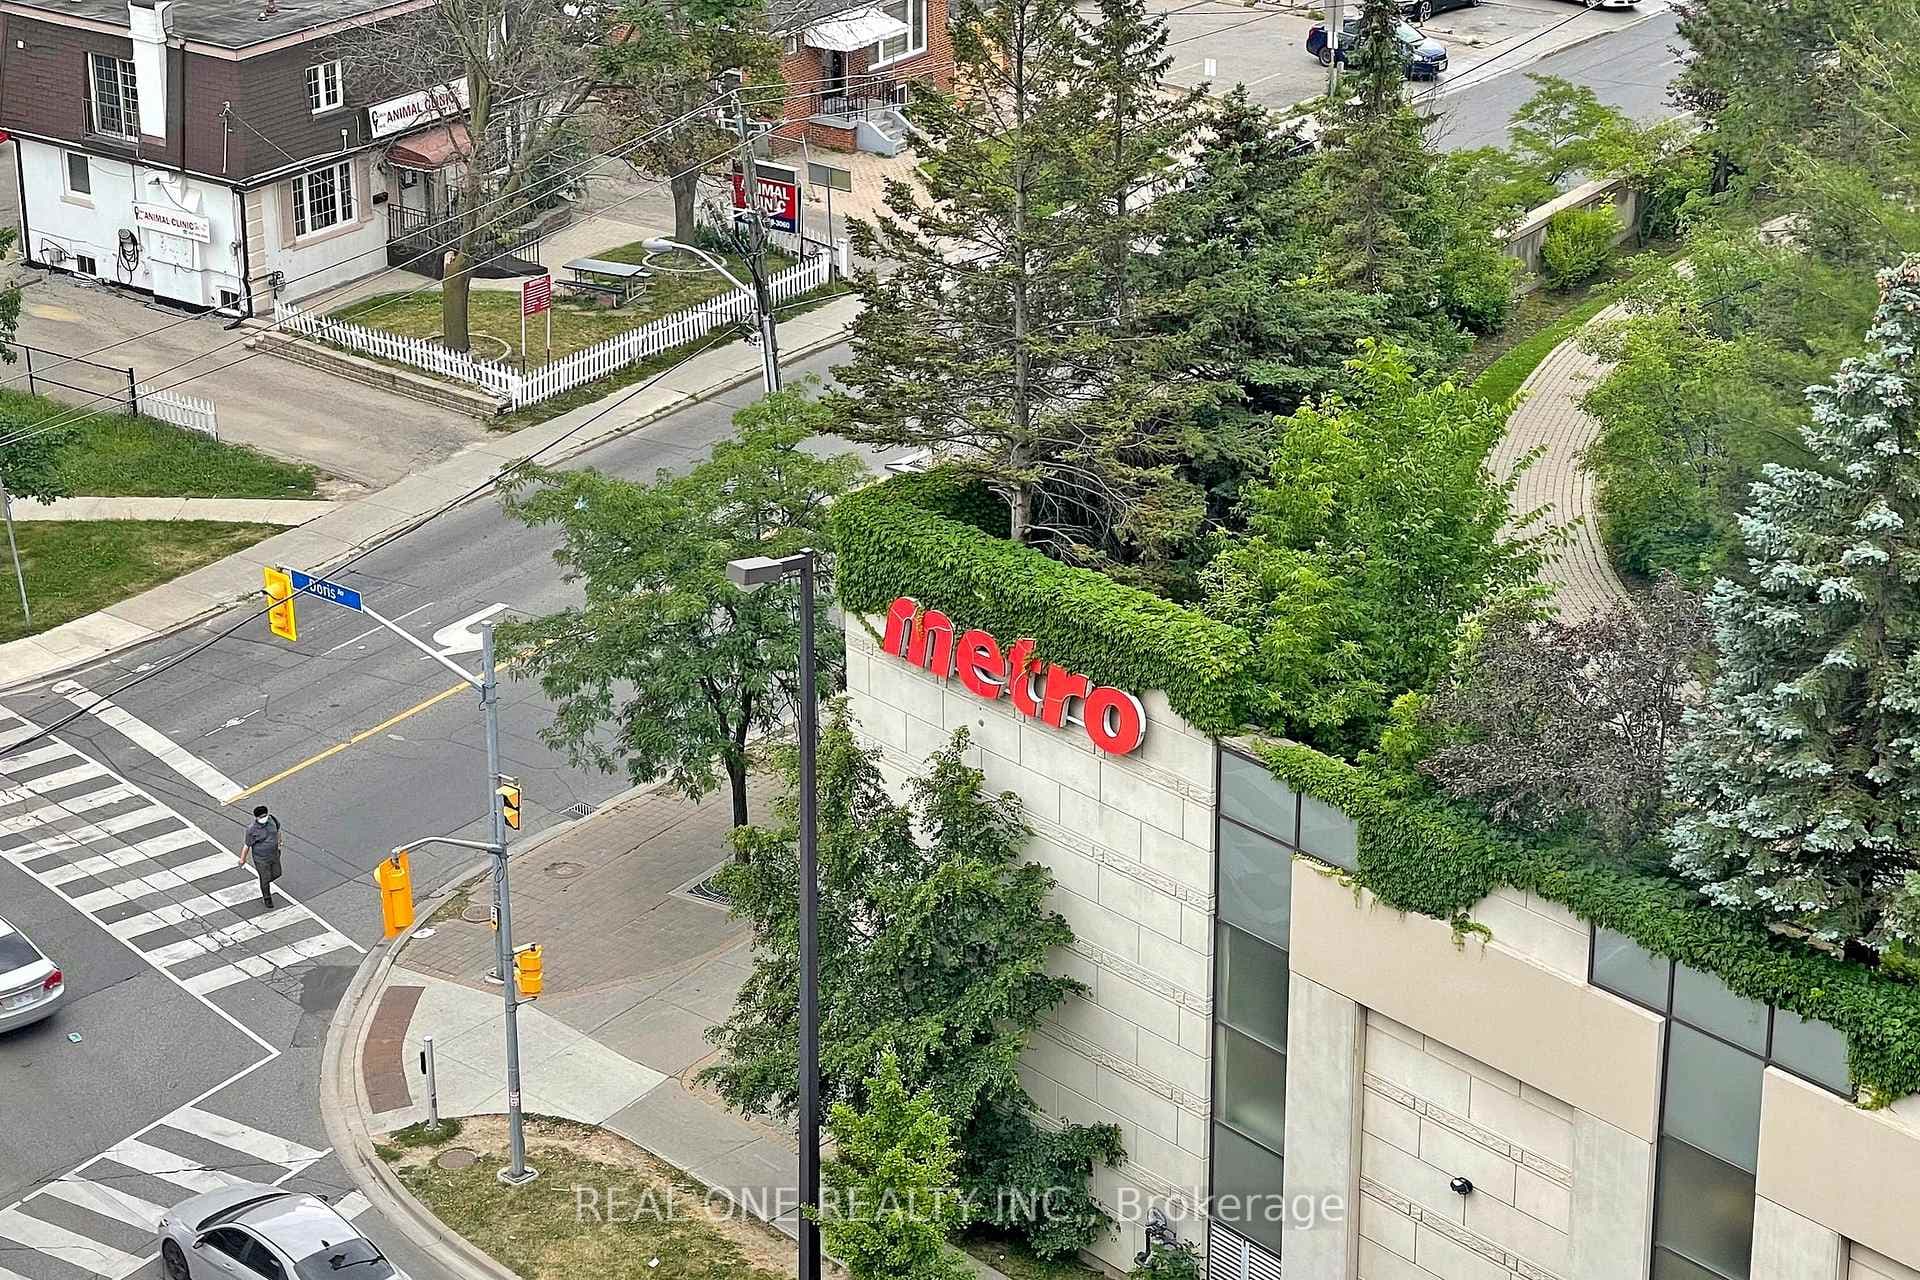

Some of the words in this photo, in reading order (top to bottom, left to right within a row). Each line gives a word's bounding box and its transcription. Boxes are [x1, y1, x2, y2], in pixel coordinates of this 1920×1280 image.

[386, 102, 422, 123] ANIMAL
[740, 179, 790, 200] IMAL
[144, 211, 170, 225] ANIMAL
[171, 218, 194, 231] CLINIC
[883, 597, 1146, 755] metro
